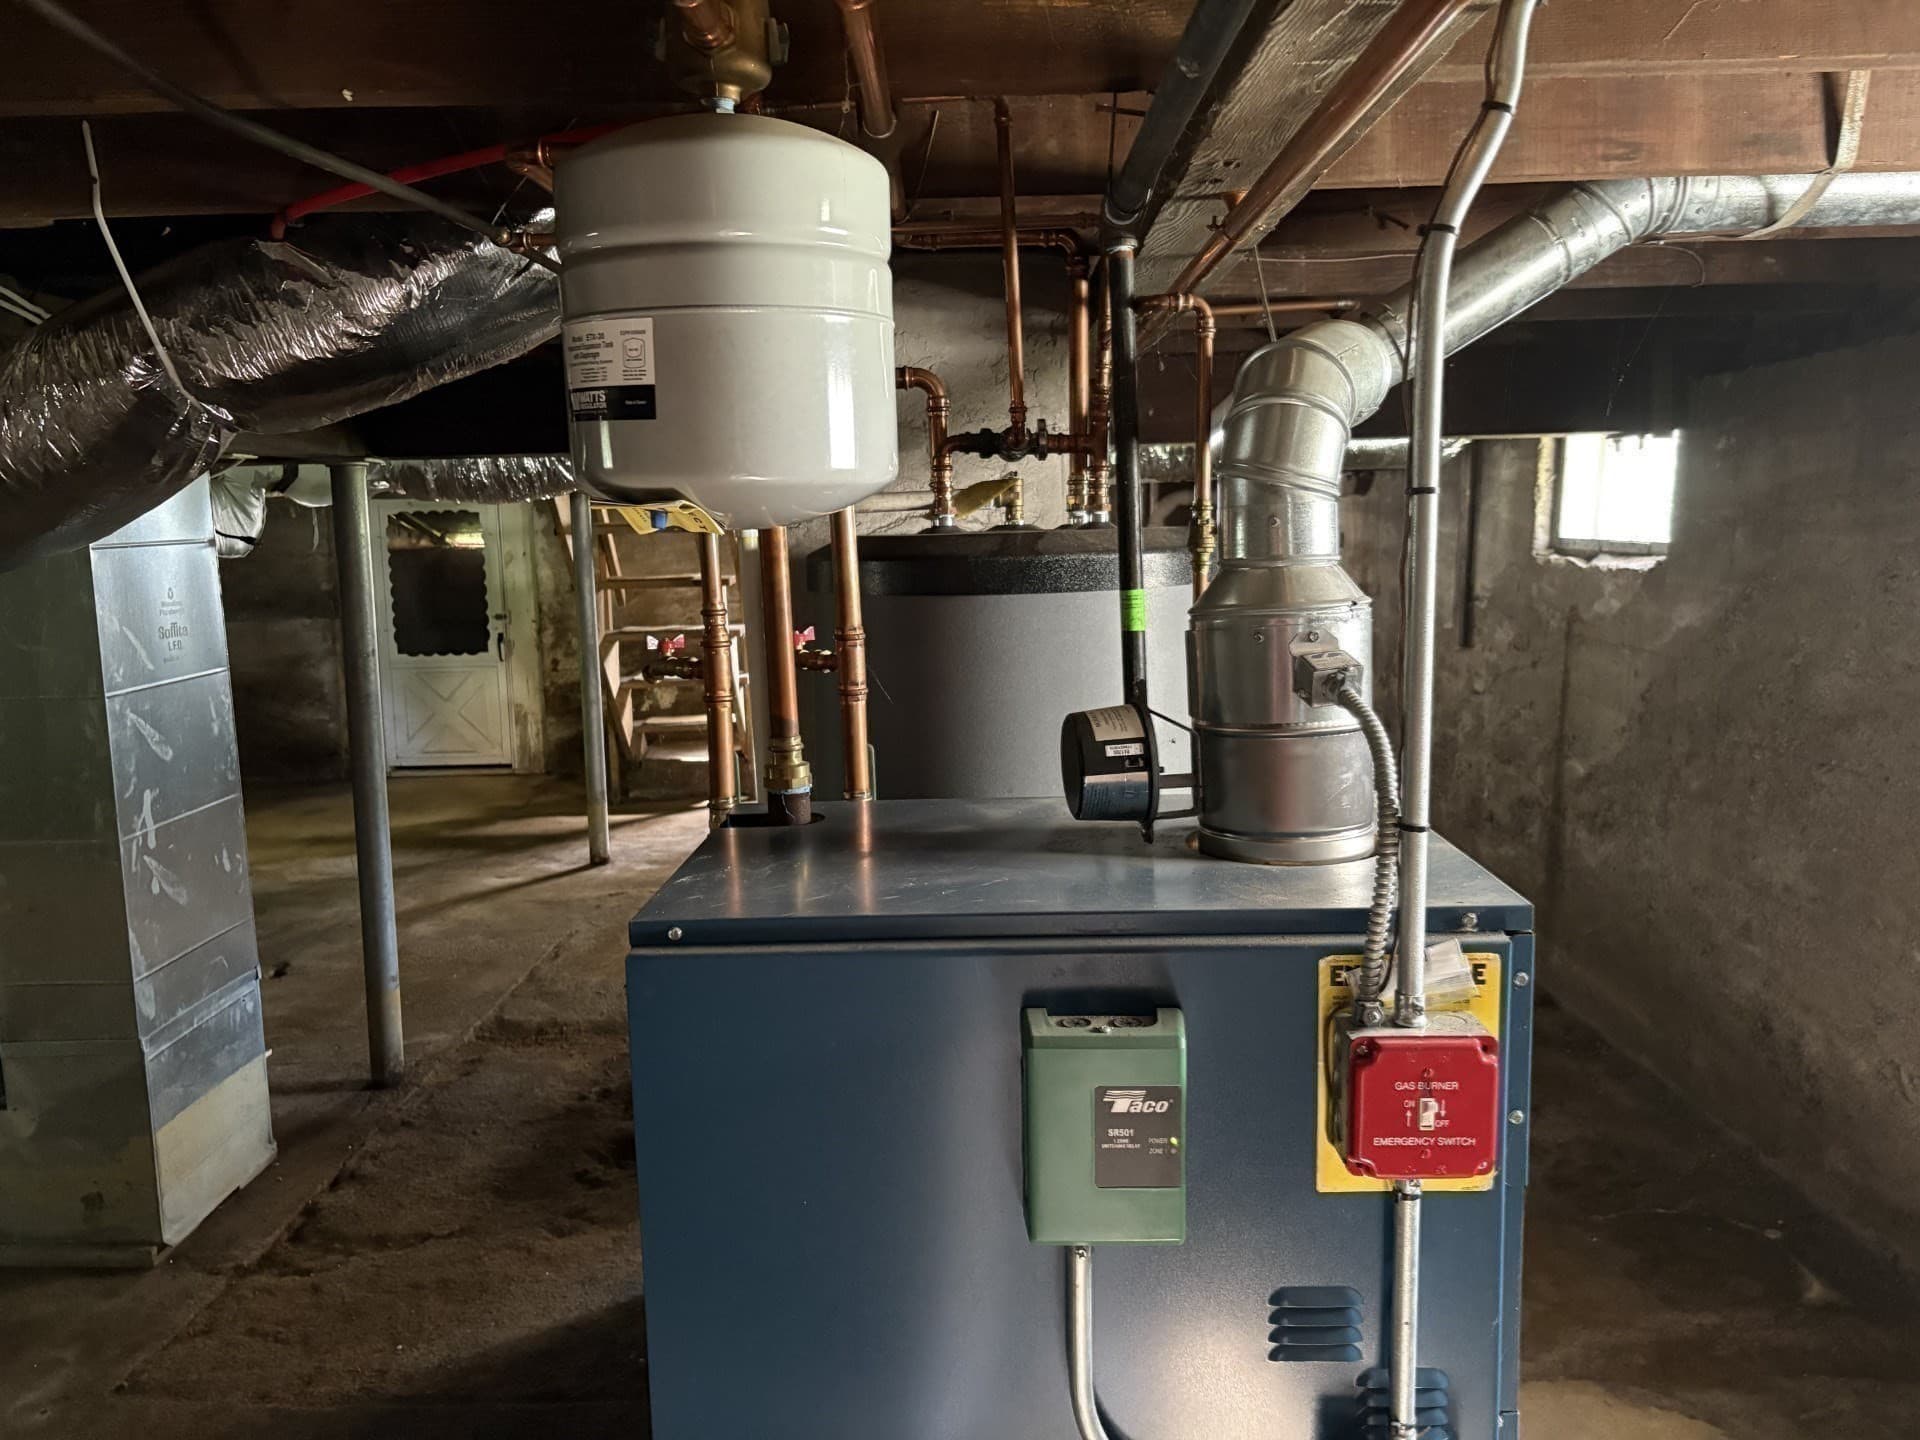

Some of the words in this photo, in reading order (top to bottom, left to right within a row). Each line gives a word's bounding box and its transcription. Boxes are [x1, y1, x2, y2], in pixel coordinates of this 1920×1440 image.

[1394, 1081, 1416, 1090] GAS
[1417, 1081, 1459, 1090] BURNER
[1102, 1090, 1169, 1113] Taco
[1403, 1099, 1415, 1108] ON
[1434, 1119, 1450, 1128] OFF
[1108, 1129, 1134, 1137] SR501
[1373, 1137, 1435, 1146] EMERGENCY
[1436, 1137, 1477, 1146] SWITCH
